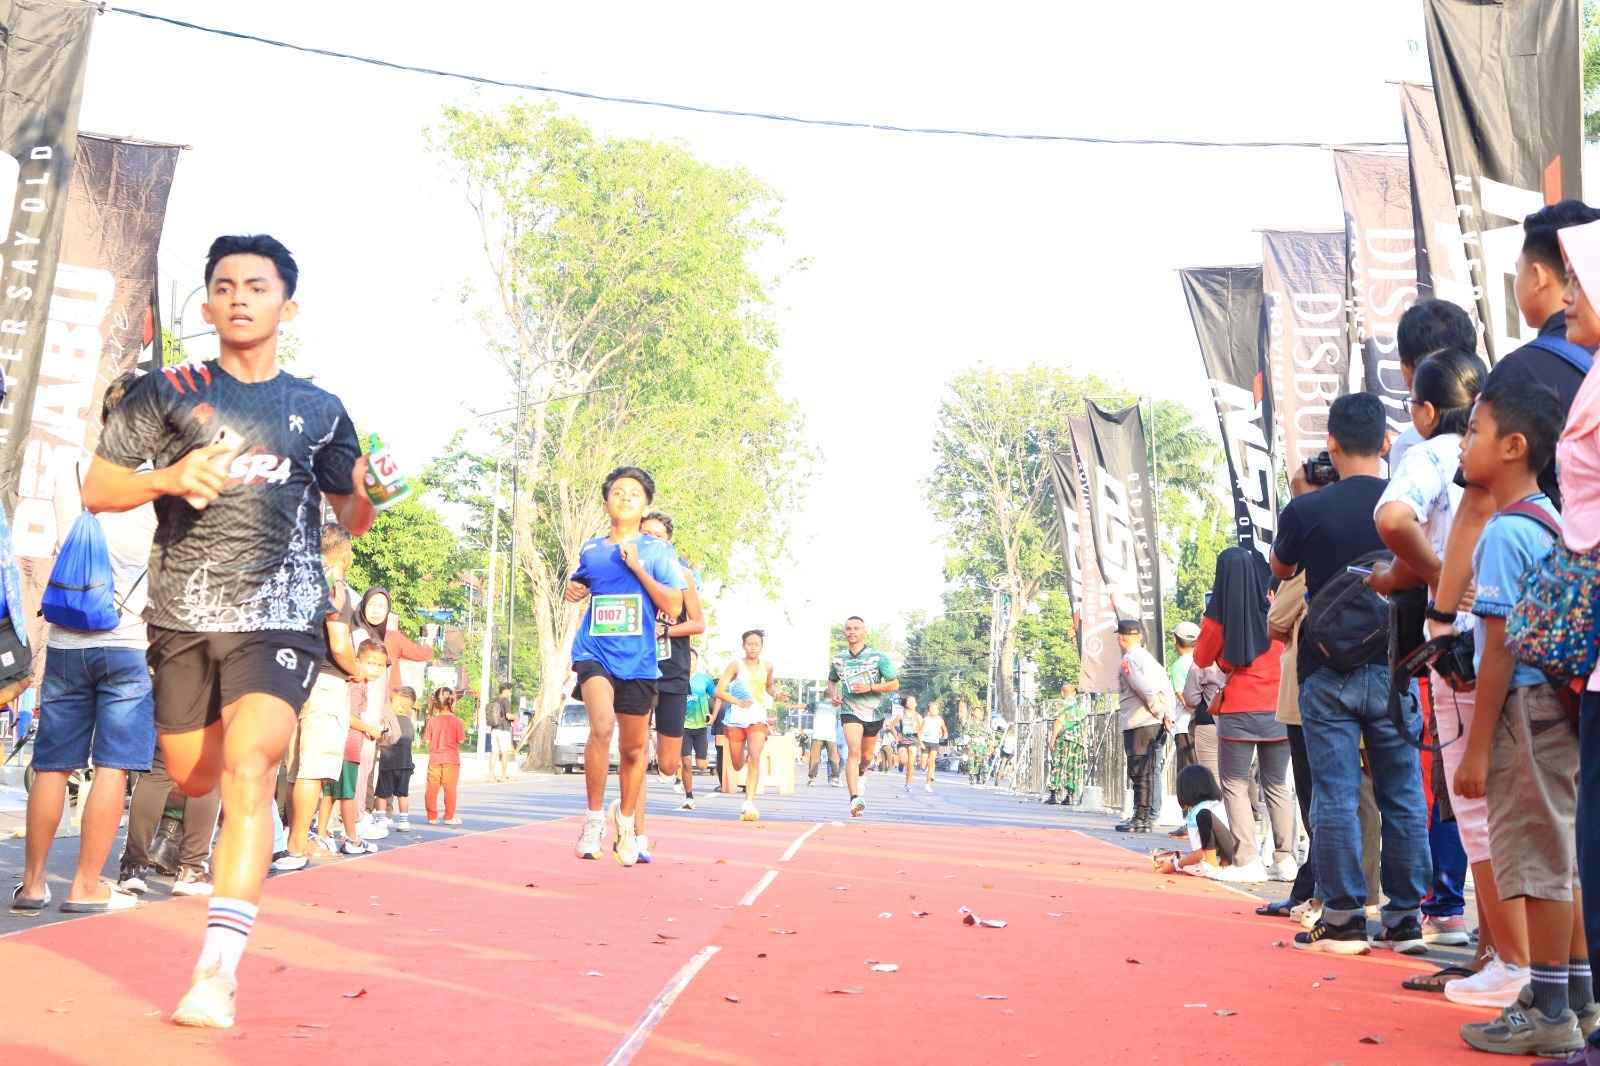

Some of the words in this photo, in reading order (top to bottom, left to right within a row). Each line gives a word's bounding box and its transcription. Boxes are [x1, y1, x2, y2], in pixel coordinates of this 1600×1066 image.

[21, 146, 52, 213] OLD
[6, 231, 40, 301] SAY
[1127, 473, 1143, 510] OLD
[1132, 516, 1149, 551] SAY
[1138, 558, 1154, 620] NEVER
[598, 609, 622, 621] 0107
